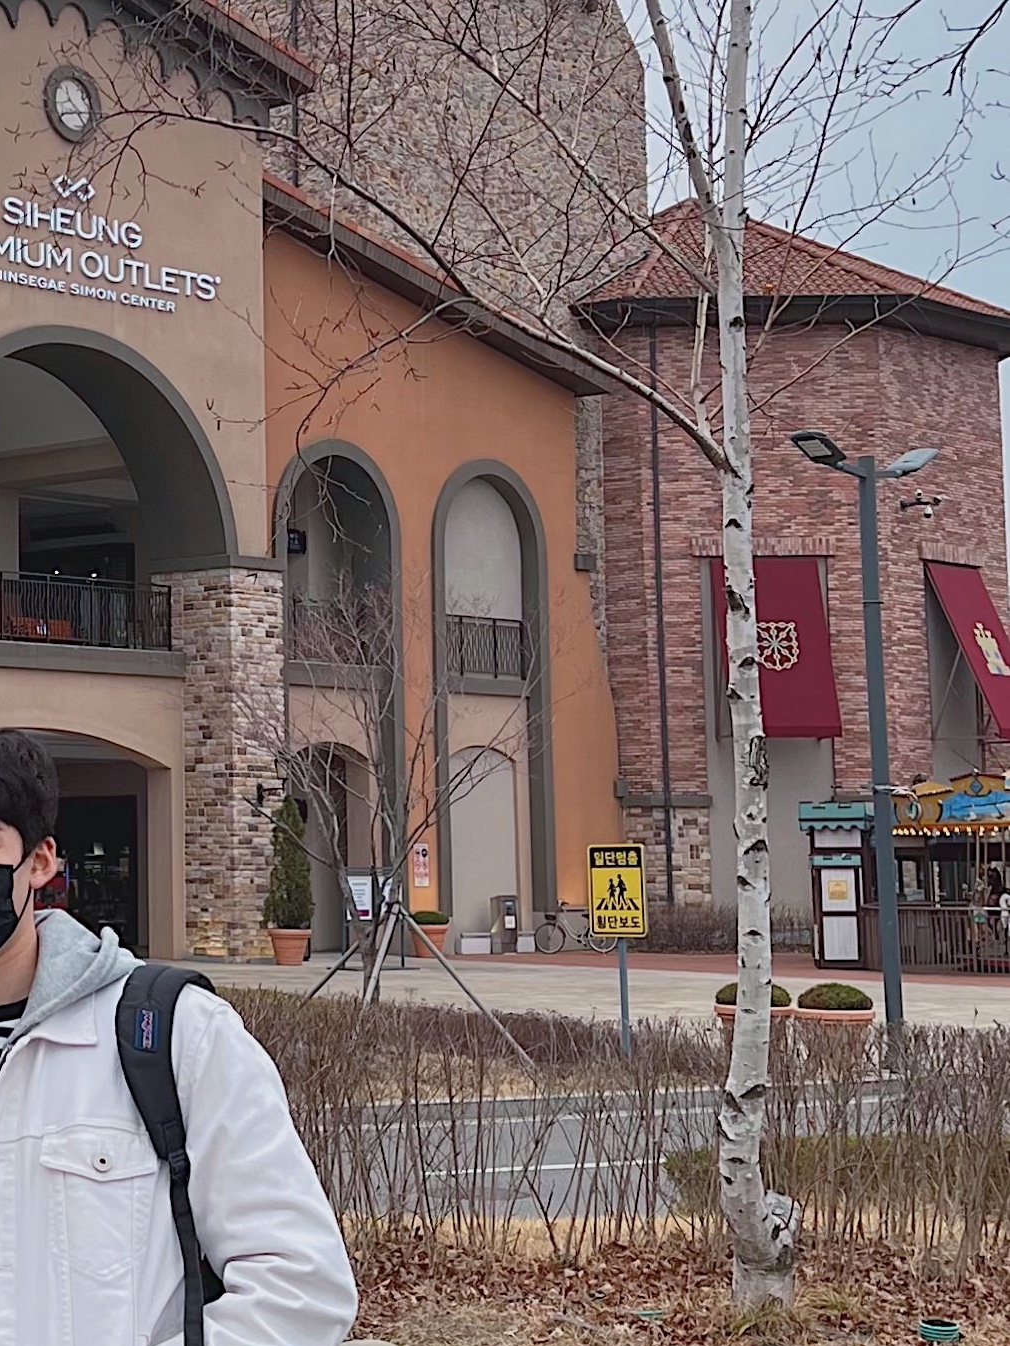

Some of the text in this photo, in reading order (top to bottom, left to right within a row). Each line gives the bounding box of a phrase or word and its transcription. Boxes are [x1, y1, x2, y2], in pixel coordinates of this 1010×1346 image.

[2, 196, 143, 249] SIHEUNG
[79, 251, 217, 301] OUTLETS
[69, 283, 117, 302] SIMON
[120, 292, 177, 313] CENTER
[593, 850, 638, 866] 일단멈춤
[596, 915, 641, 929] 횡단보도
